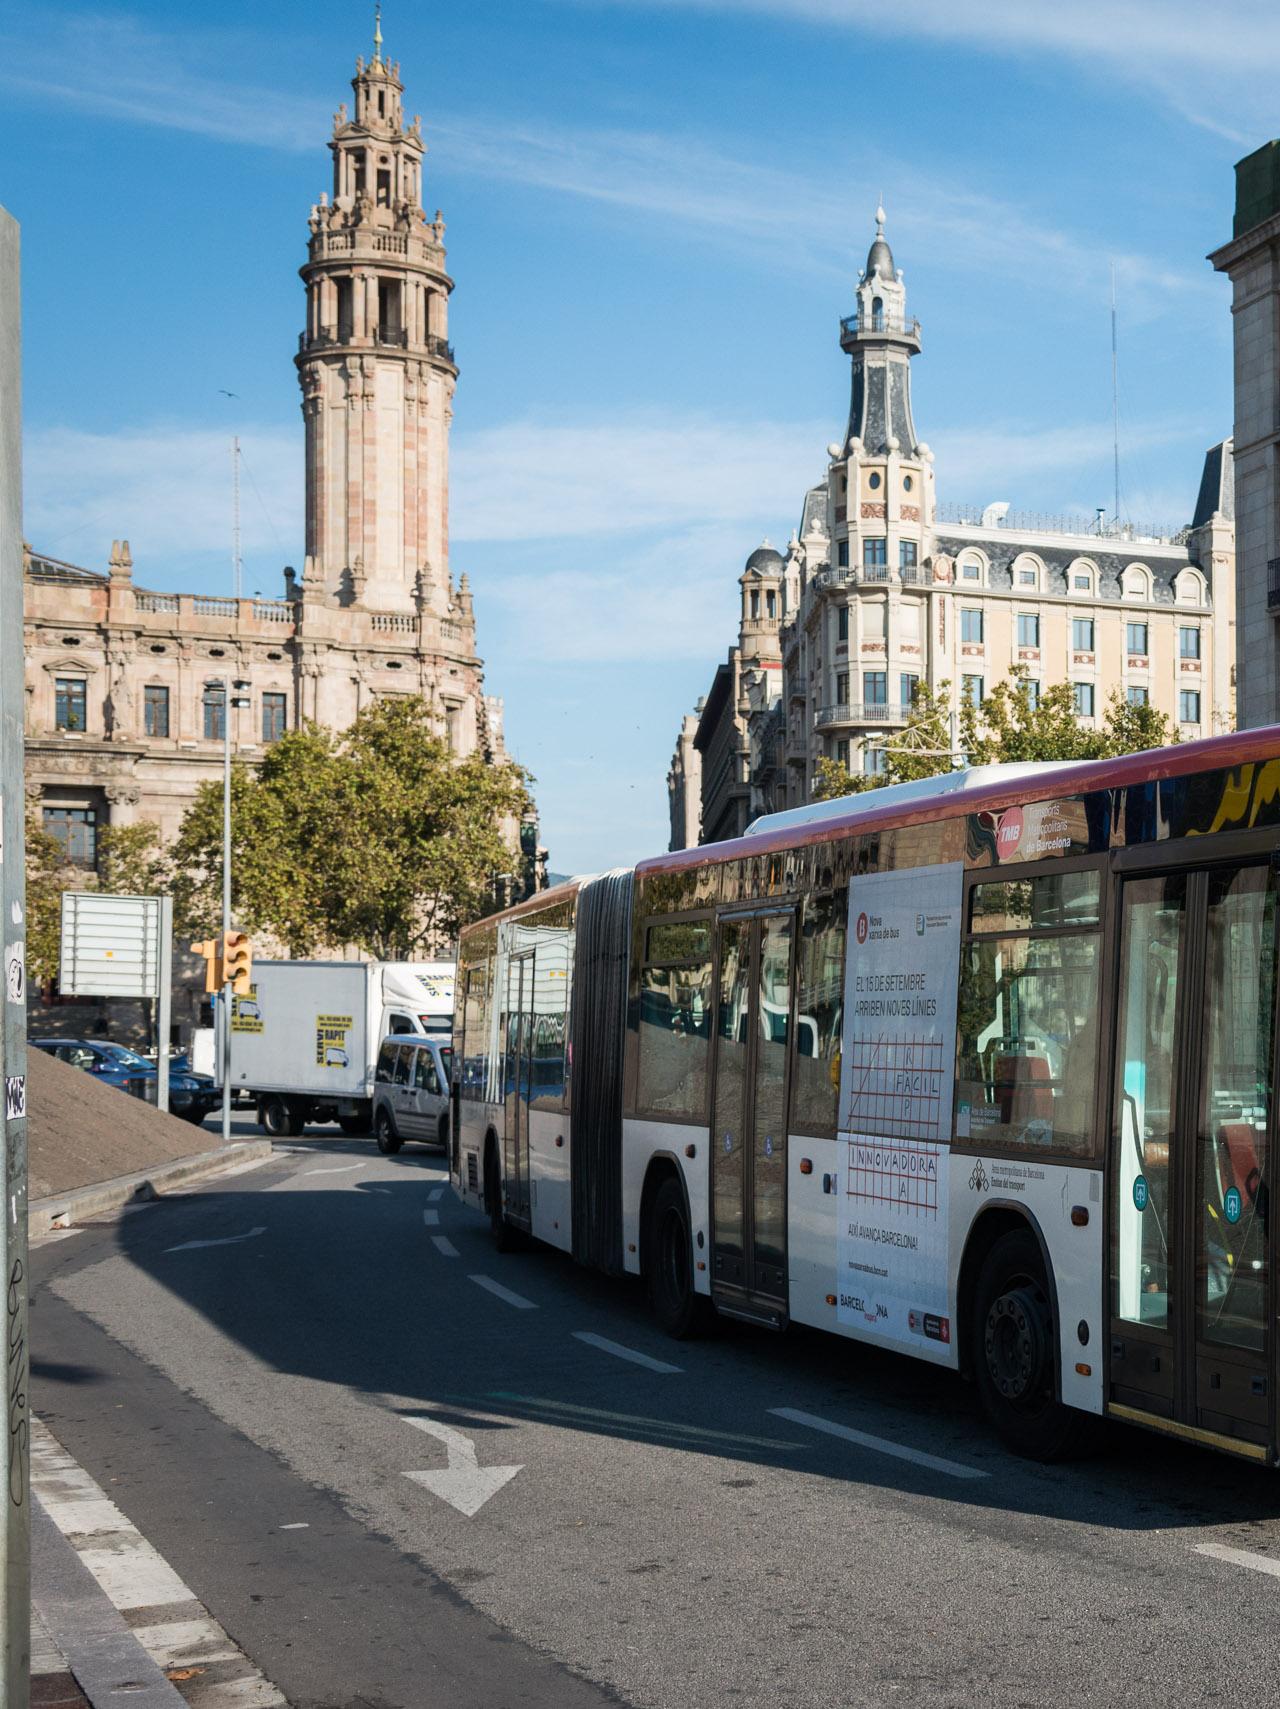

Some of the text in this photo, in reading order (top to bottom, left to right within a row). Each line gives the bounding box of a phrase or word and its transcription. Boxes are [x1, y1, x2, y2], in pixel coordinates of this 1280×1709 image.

[1029, 805, 1060, 818] Transports
[1000, 824, 1020, 842] TMB
[1036, 837, 1071, 852] Barcelona
[869, 915, 882, 927] Nova
[869, 928, 900, 940] xarxa de bus
[856, 973, 926, 992] EL 15 DE SETEMBRE
[854, 995, 937, 1016] ARRIBEN NOVES LÍNIES
[325, 1029, 345, 1040] RAPIT
[851, 1147, 936, 1174] INNOVADORA
[859, 1225, 881, 1245] AVANÇA
